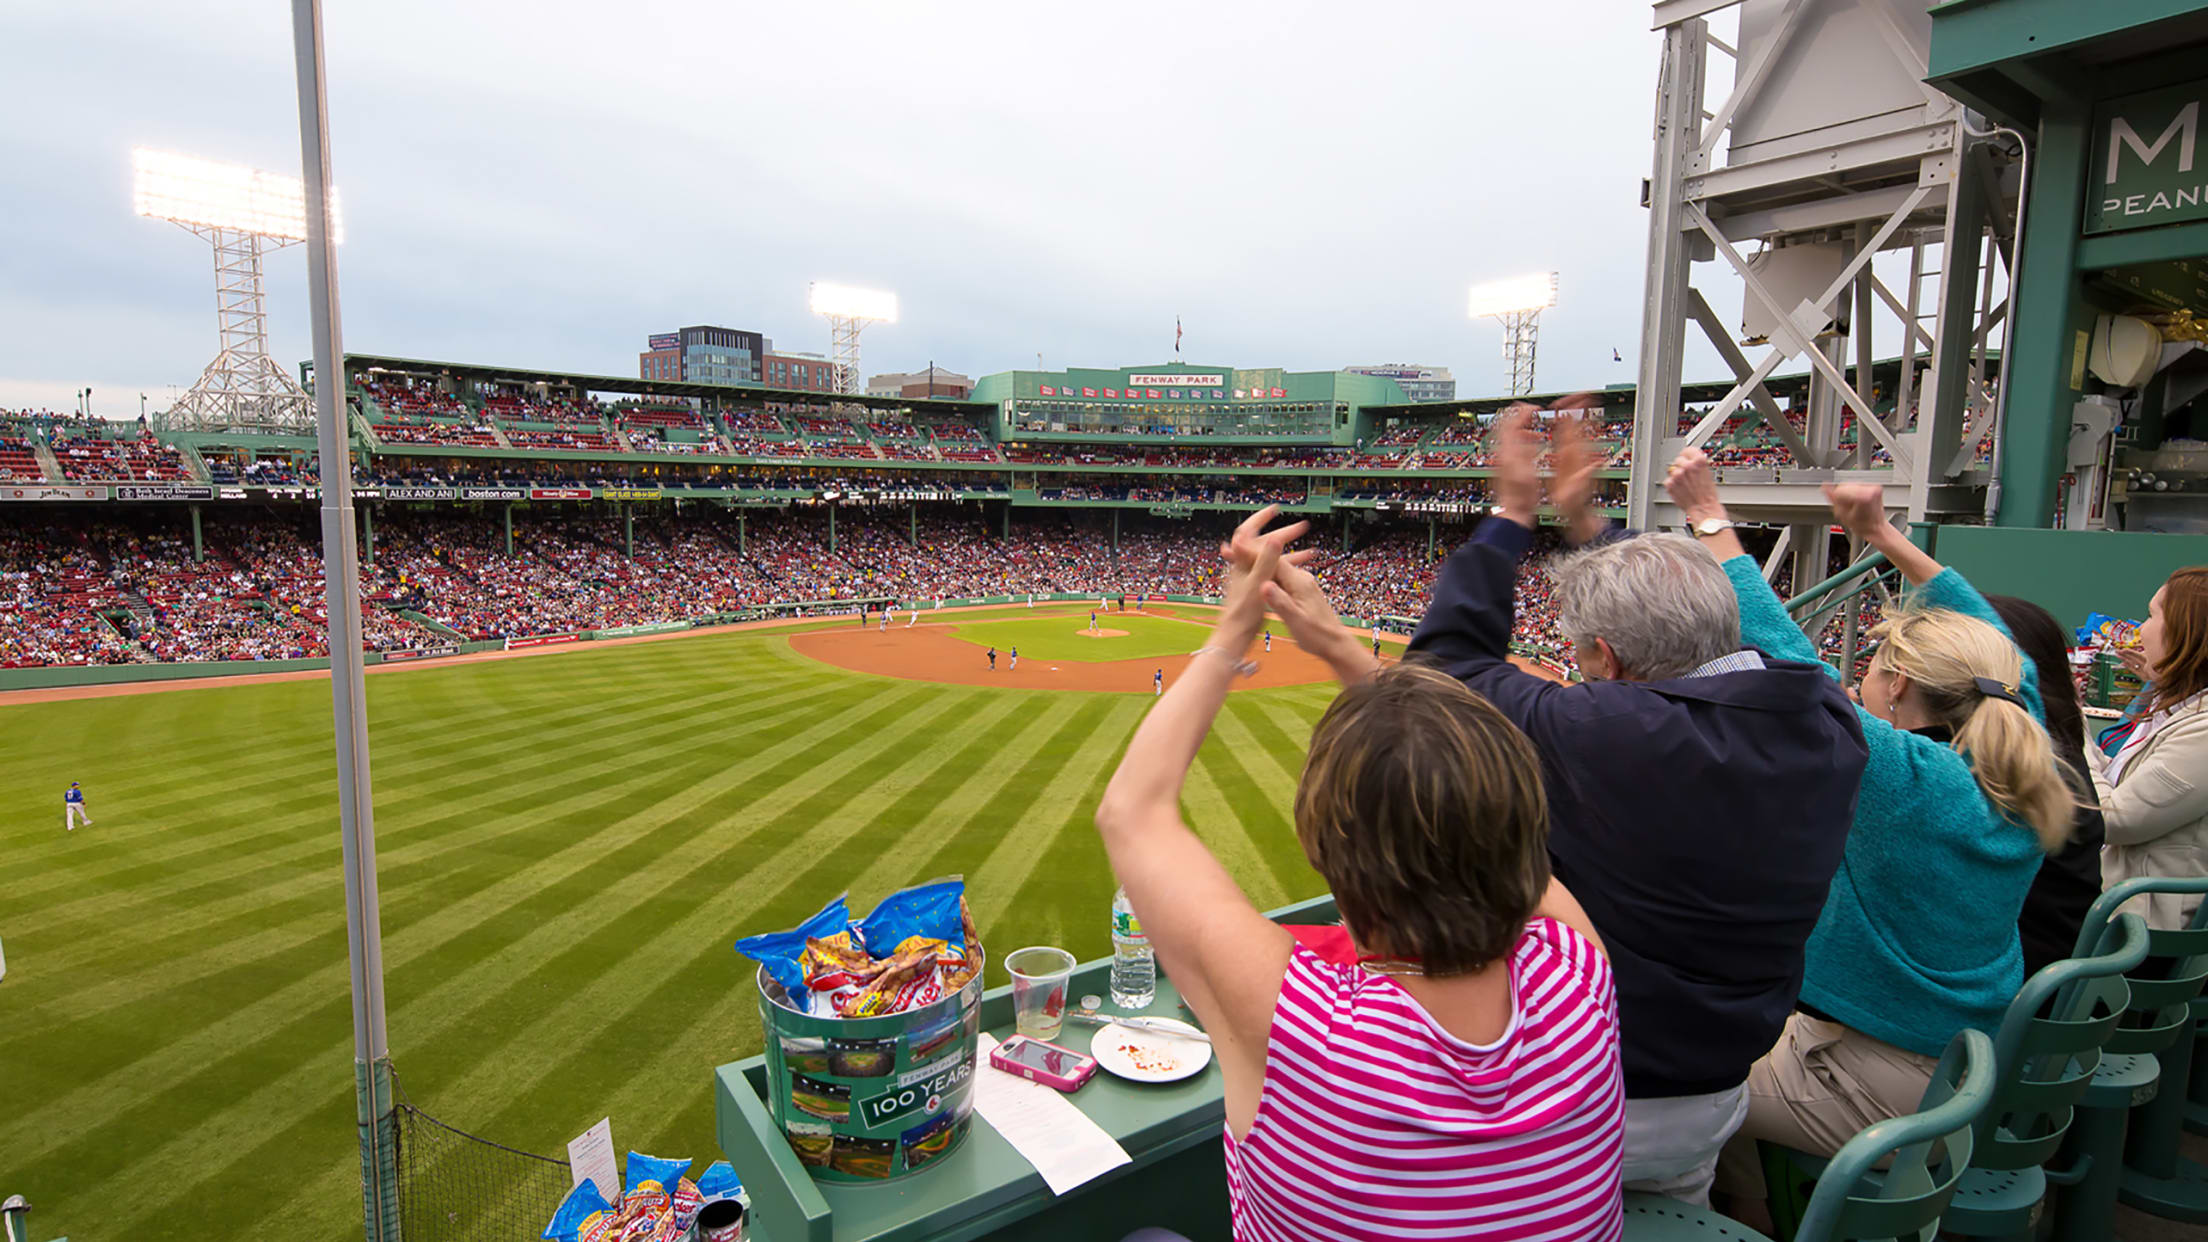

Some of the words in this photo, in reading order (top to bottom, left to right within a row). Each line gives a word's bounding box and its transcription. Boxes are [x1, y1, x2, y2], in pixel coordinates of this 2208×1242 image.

[2103, 184, 2208, 216] PEAN
[1134, 376, 1181, 384] FENWAY
[1186, 376, 1217, 384] PARK
[389, 489, 413, 497] ALEX
[414, 489, 435, 497] AND
[920, 1060, 972, 1097] YEARS
